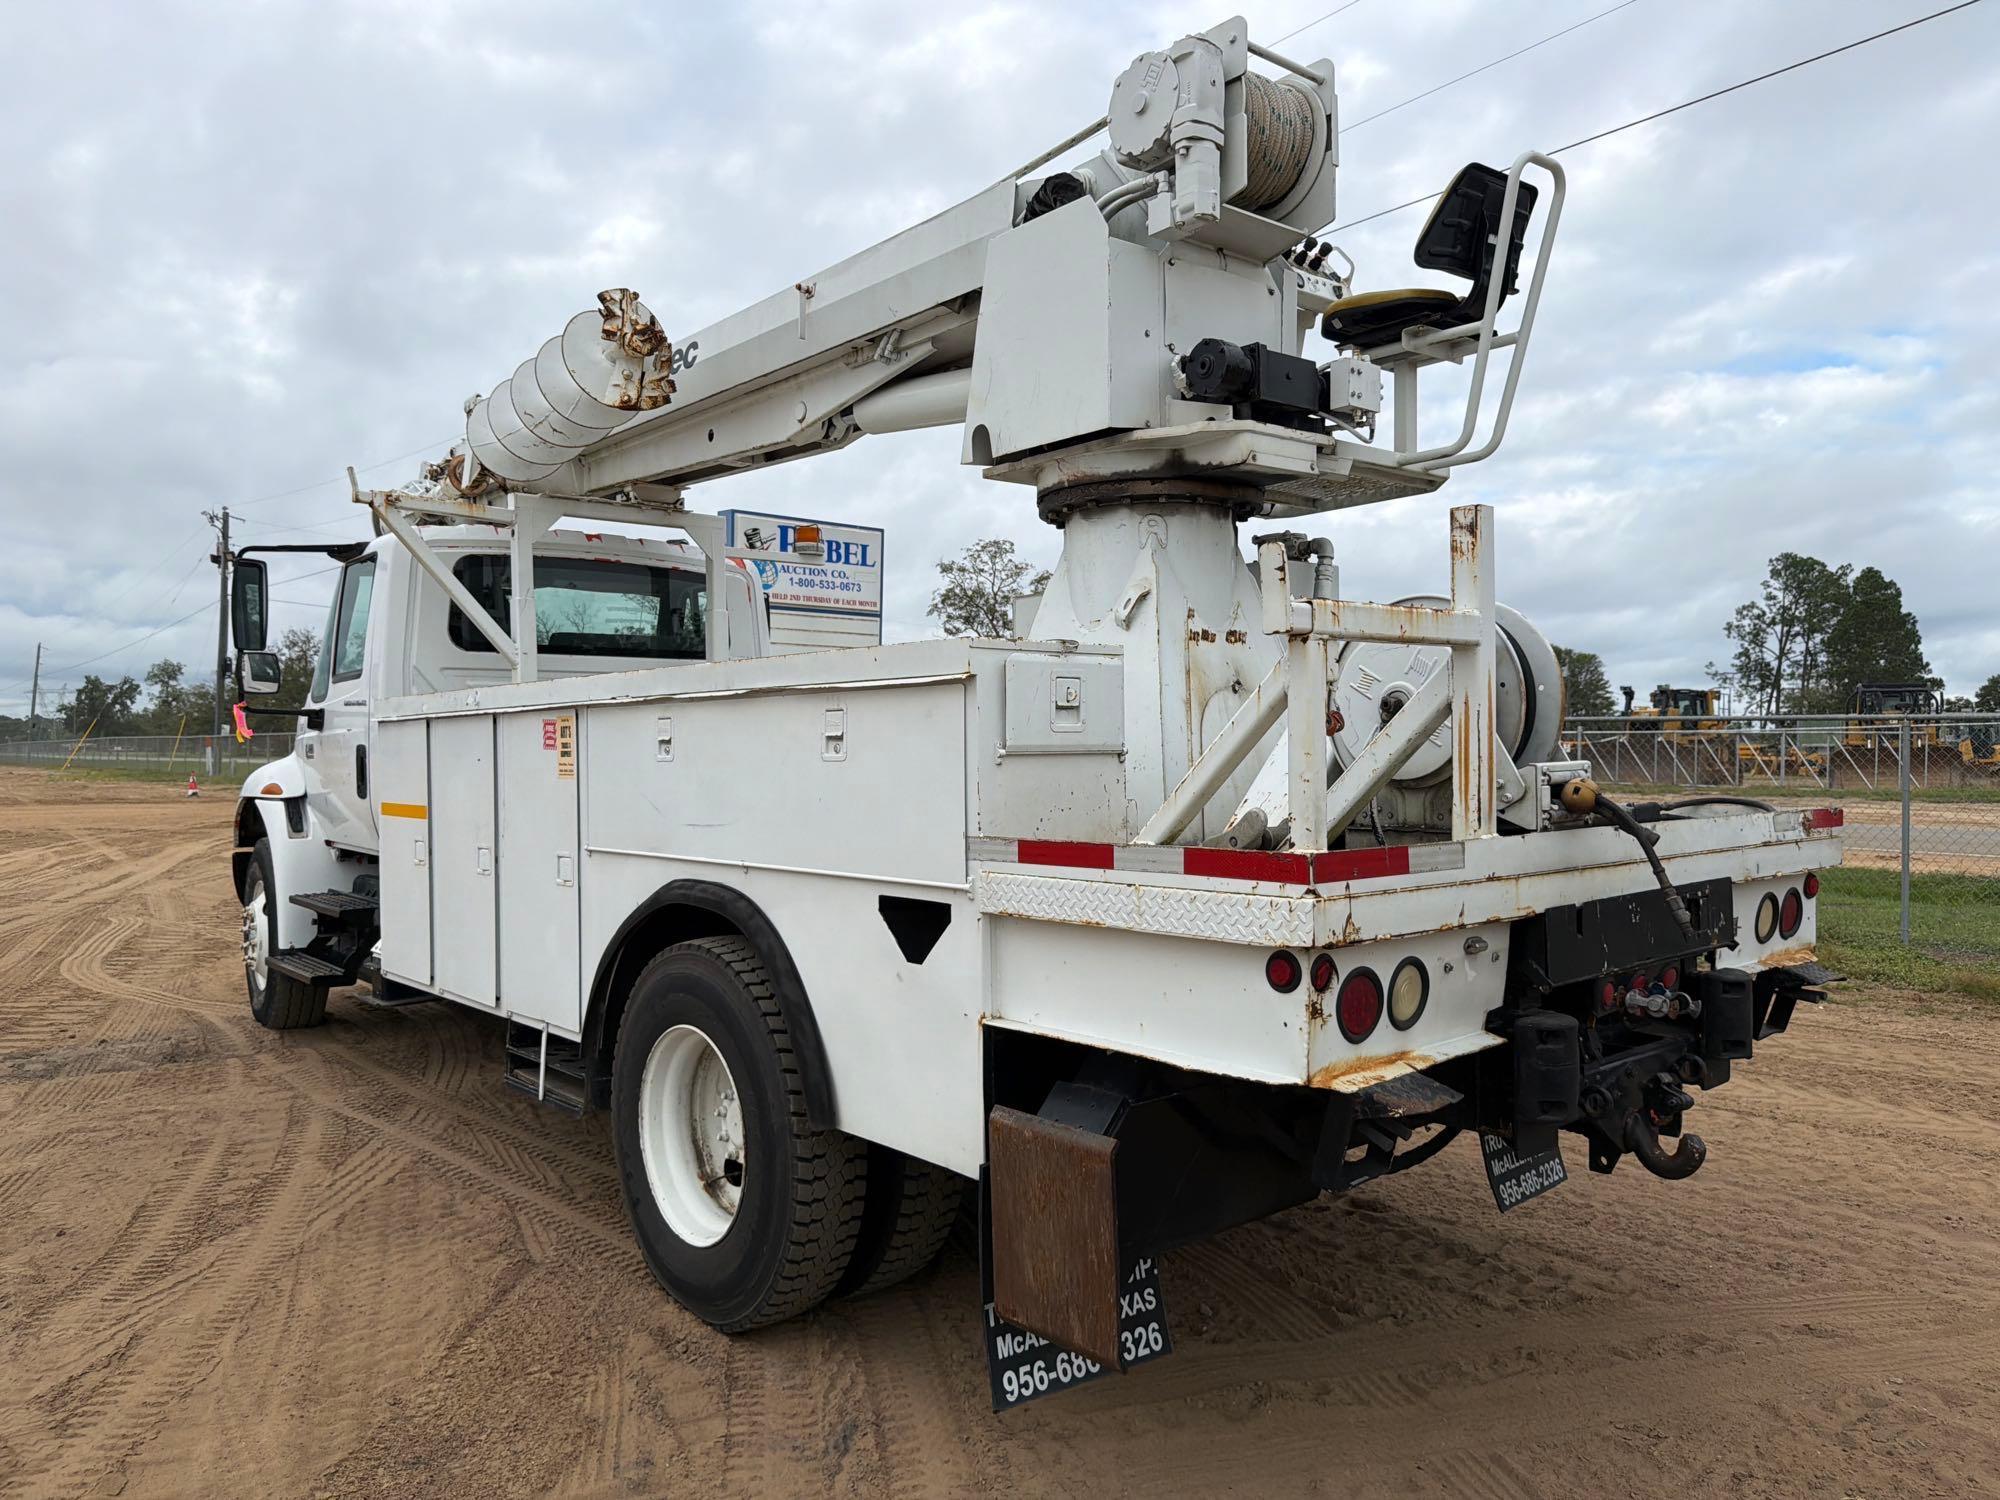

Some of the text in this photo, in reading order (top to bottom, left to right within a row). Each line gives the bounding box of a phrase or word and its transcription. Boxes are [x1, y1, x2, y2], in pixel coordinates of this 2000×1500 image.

[777, 524, 877, 568] BEL
[779, 564, 850, 580] AUCTION CO.
[788, 577, 862, 593] 1-800-533-0673
[772, 592, 788, 601] HELD
[789, 594, 801, 602] 2ND
[802, 595, 832, 605] THURSDAY
[857, 600, 878, 608] MONTH
[1484, 1134, 1508, 1154] TRU
[1499, 1158, 1564, 1206] 956-686-2326
[1119, 1287, 1157, 1319] XAS
